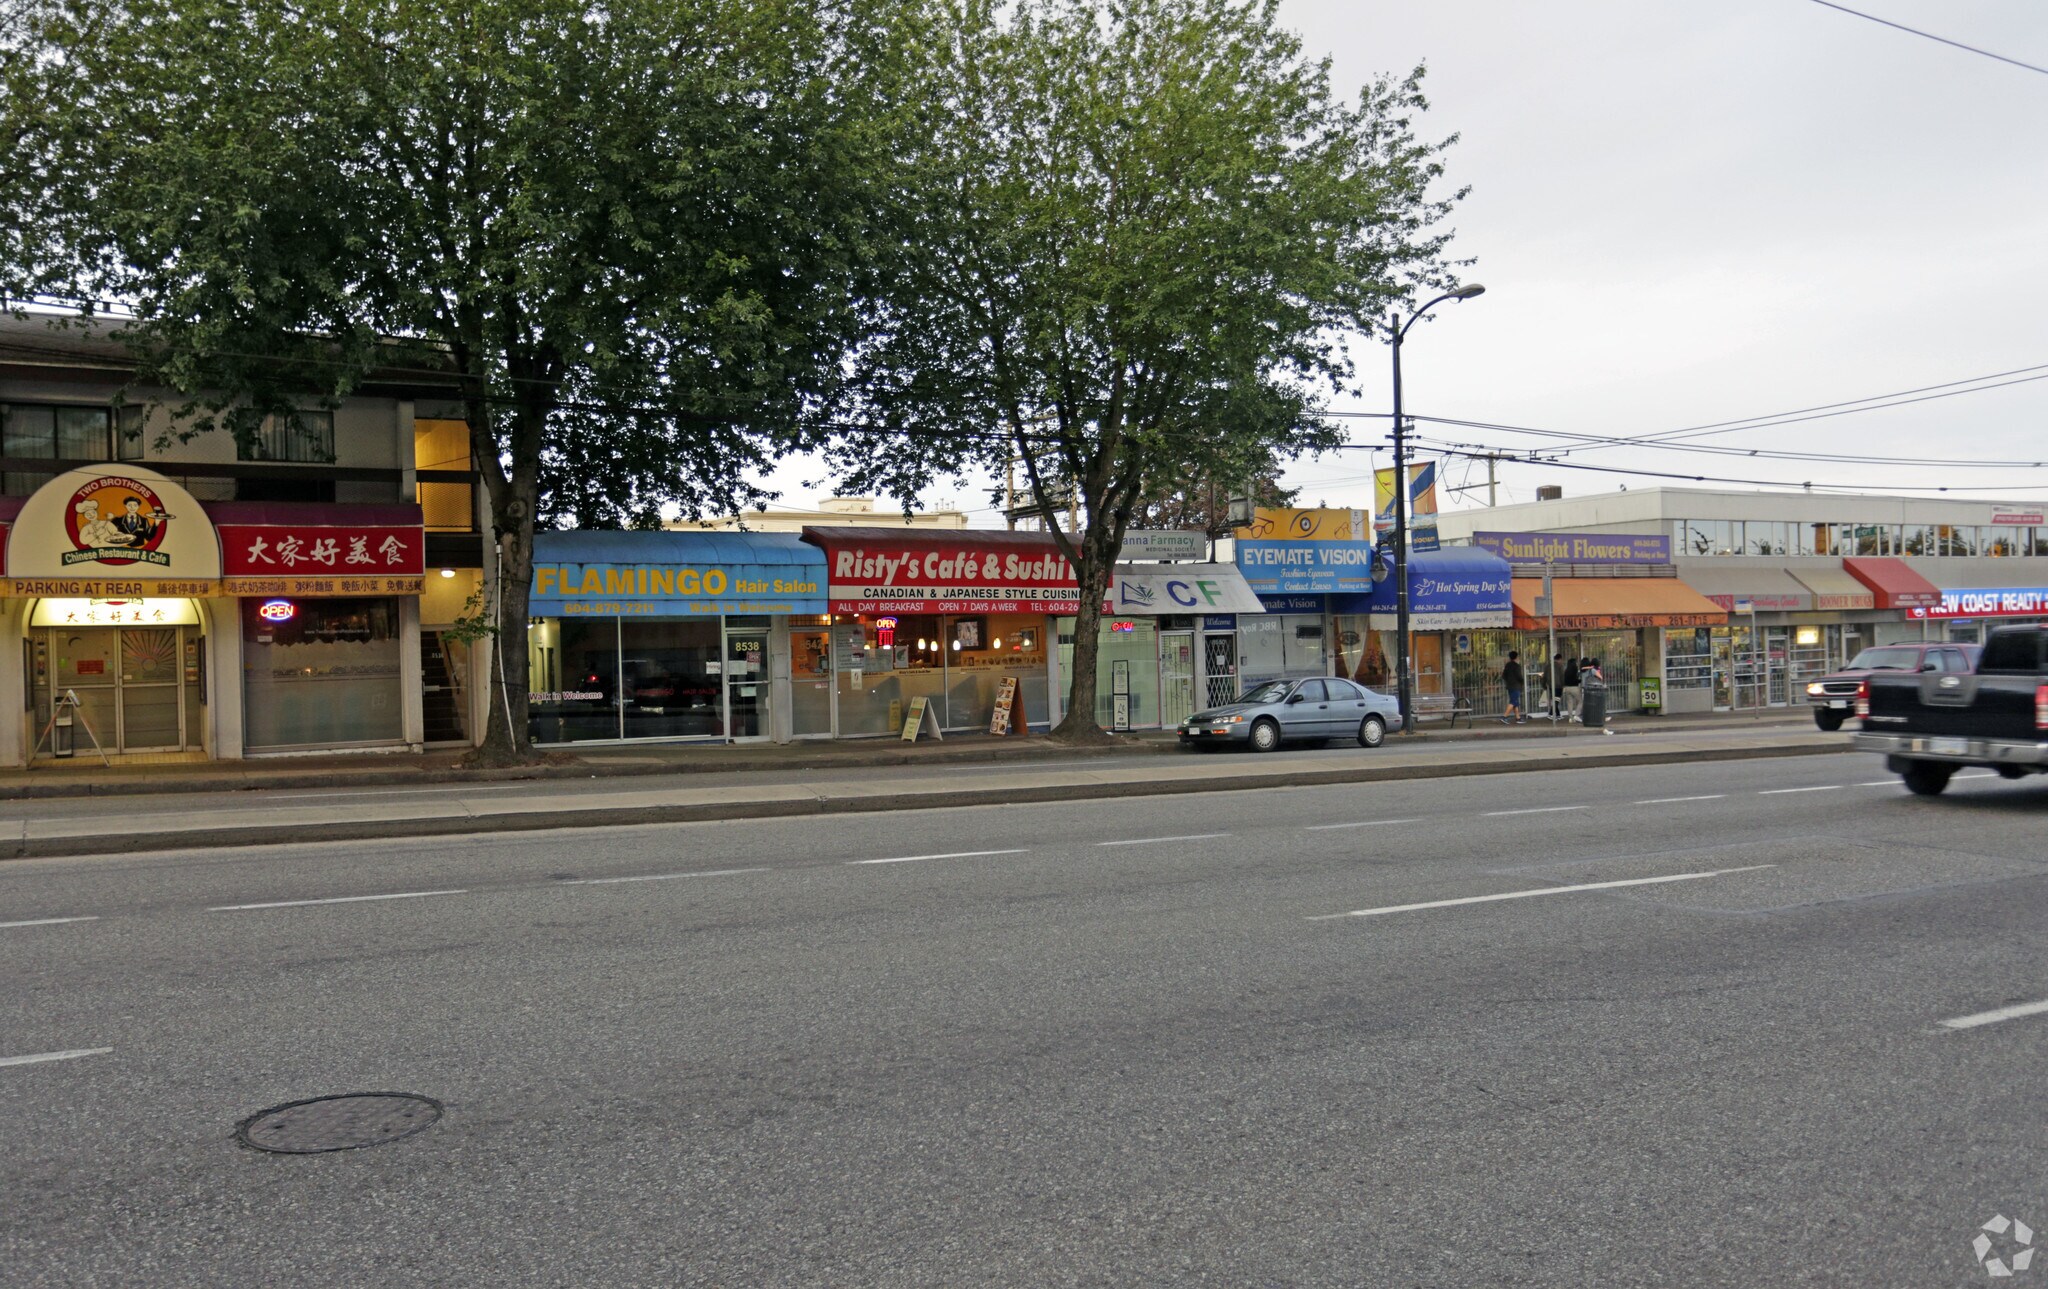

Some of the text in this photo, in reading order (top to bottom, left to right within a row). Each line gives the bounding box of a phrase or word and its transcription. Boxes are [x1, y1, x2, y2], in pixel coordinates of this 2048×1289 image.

[78, 478, 152, 498] TWO BROTHERS
[1123, 535, 1194, 547] anna Farmacy
[248, 535, 408, 567] 大家好美食
[1503, 538, 1568, 561] Sunlight
[1573, 539, 1631, 559] Flowers
[65, 551, 98, 564] Chinese
[98, 548, 140, 559] Restaurant
[148, 552, 167, 564] Cafe
[1244, 549, 1367, 565] EYEMATE VISION
[836, 550, 919, 586] Risty's
[924, 552, 978, 579] Café
[982, 553, 1001, 579] &
[1004, 553, 1065, 580] Sushi
[1280, 568, 1335, 579] Fashion Eyewear
[341, 580, 379, 592] 晚飯小菜
[537, 568, 817, 595] FLAMINGO Hair Salon
[1284, 581, 1309, 591] Contact
[1311, 581, 1332, 590] Lenses
[1436, 580, 1510, 594] Hot Spring Day Spa
[15, 582, 143, 595] PARKING AT REAR
[864, 588, 1080, 599] CANADIAN & JAPANESE STYLE CUISIN
[838, 603, 853, 612] ALL
[858, 603, 876, 612] DAY
[880, 602, 924, 612] BREAKFAST
[938, 602, 960, 611] OPEN
[963, 602, 967, 611] 7
[970, 602, 989, 611] DAYS
[991, 602, 998, 611] A
[998, 602, 1017, 611] WEEK
[1031, 603, 1047, 611] TEL:
[1288, 599, 1316, 607] Vision
[1819, 595, 1872, 608] BOOMER DRUGS
[1962, 593, 1999, 612] COAST
[2002, 592, 2041, 611] REALTY
[260, 605, 294, 618] OPEN
[565, 602, 793, 614] 604-879-7211 Walk in Welcome
[877, 619, 895, 628] OPEN
[1556, 617, 1599, 627] SUNLIGHT
[736, 642, 759, 651] 8538
[529, 691, 603, 700] Walk in Welcome
[1645, 692, 1656, 700] 50
